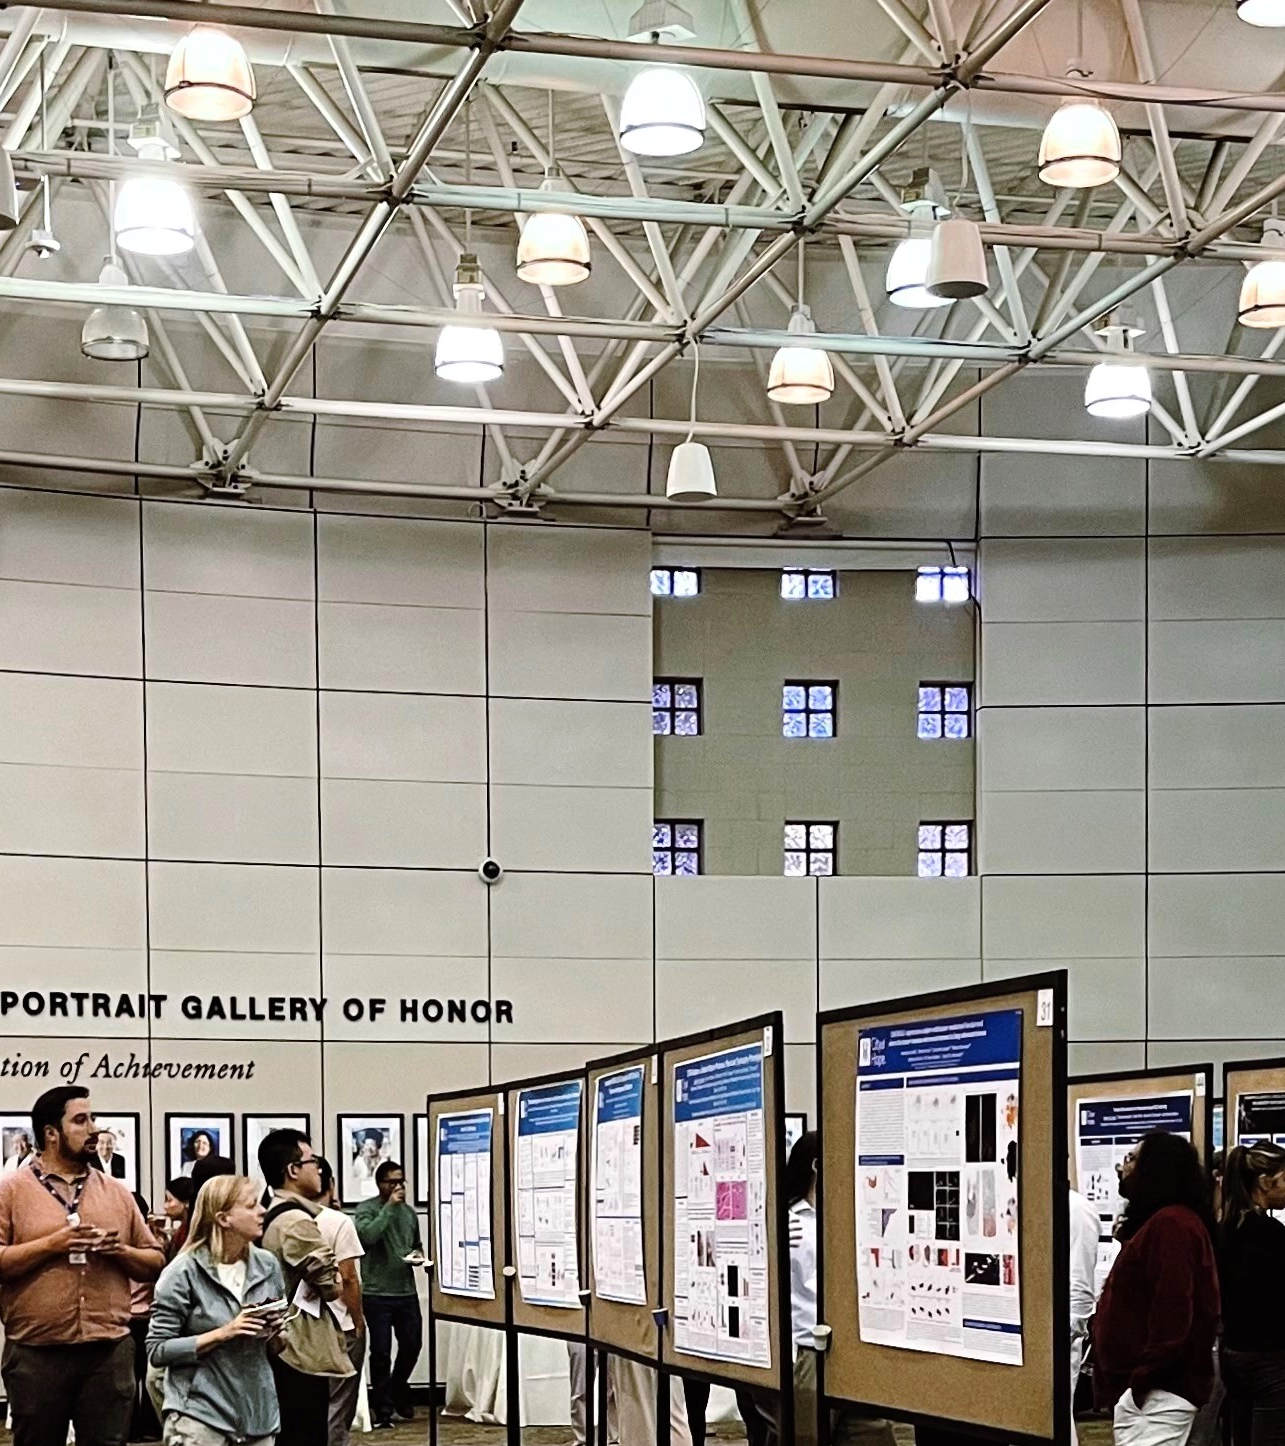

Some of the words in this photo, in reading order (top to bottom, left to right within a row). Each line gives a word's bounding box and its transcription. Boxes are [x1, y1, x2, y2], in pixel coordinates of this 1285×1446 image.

[0, 990, 168, 1019] PORTRAIT
[180, 995, 328, 1021] GALLERY
[342, 997, 387, 1022] OF
[399, 998, 514, 1024] HONOR
[59, 1053, 89, 1084] of
[91, 1053, 256, 1080] Achievement
